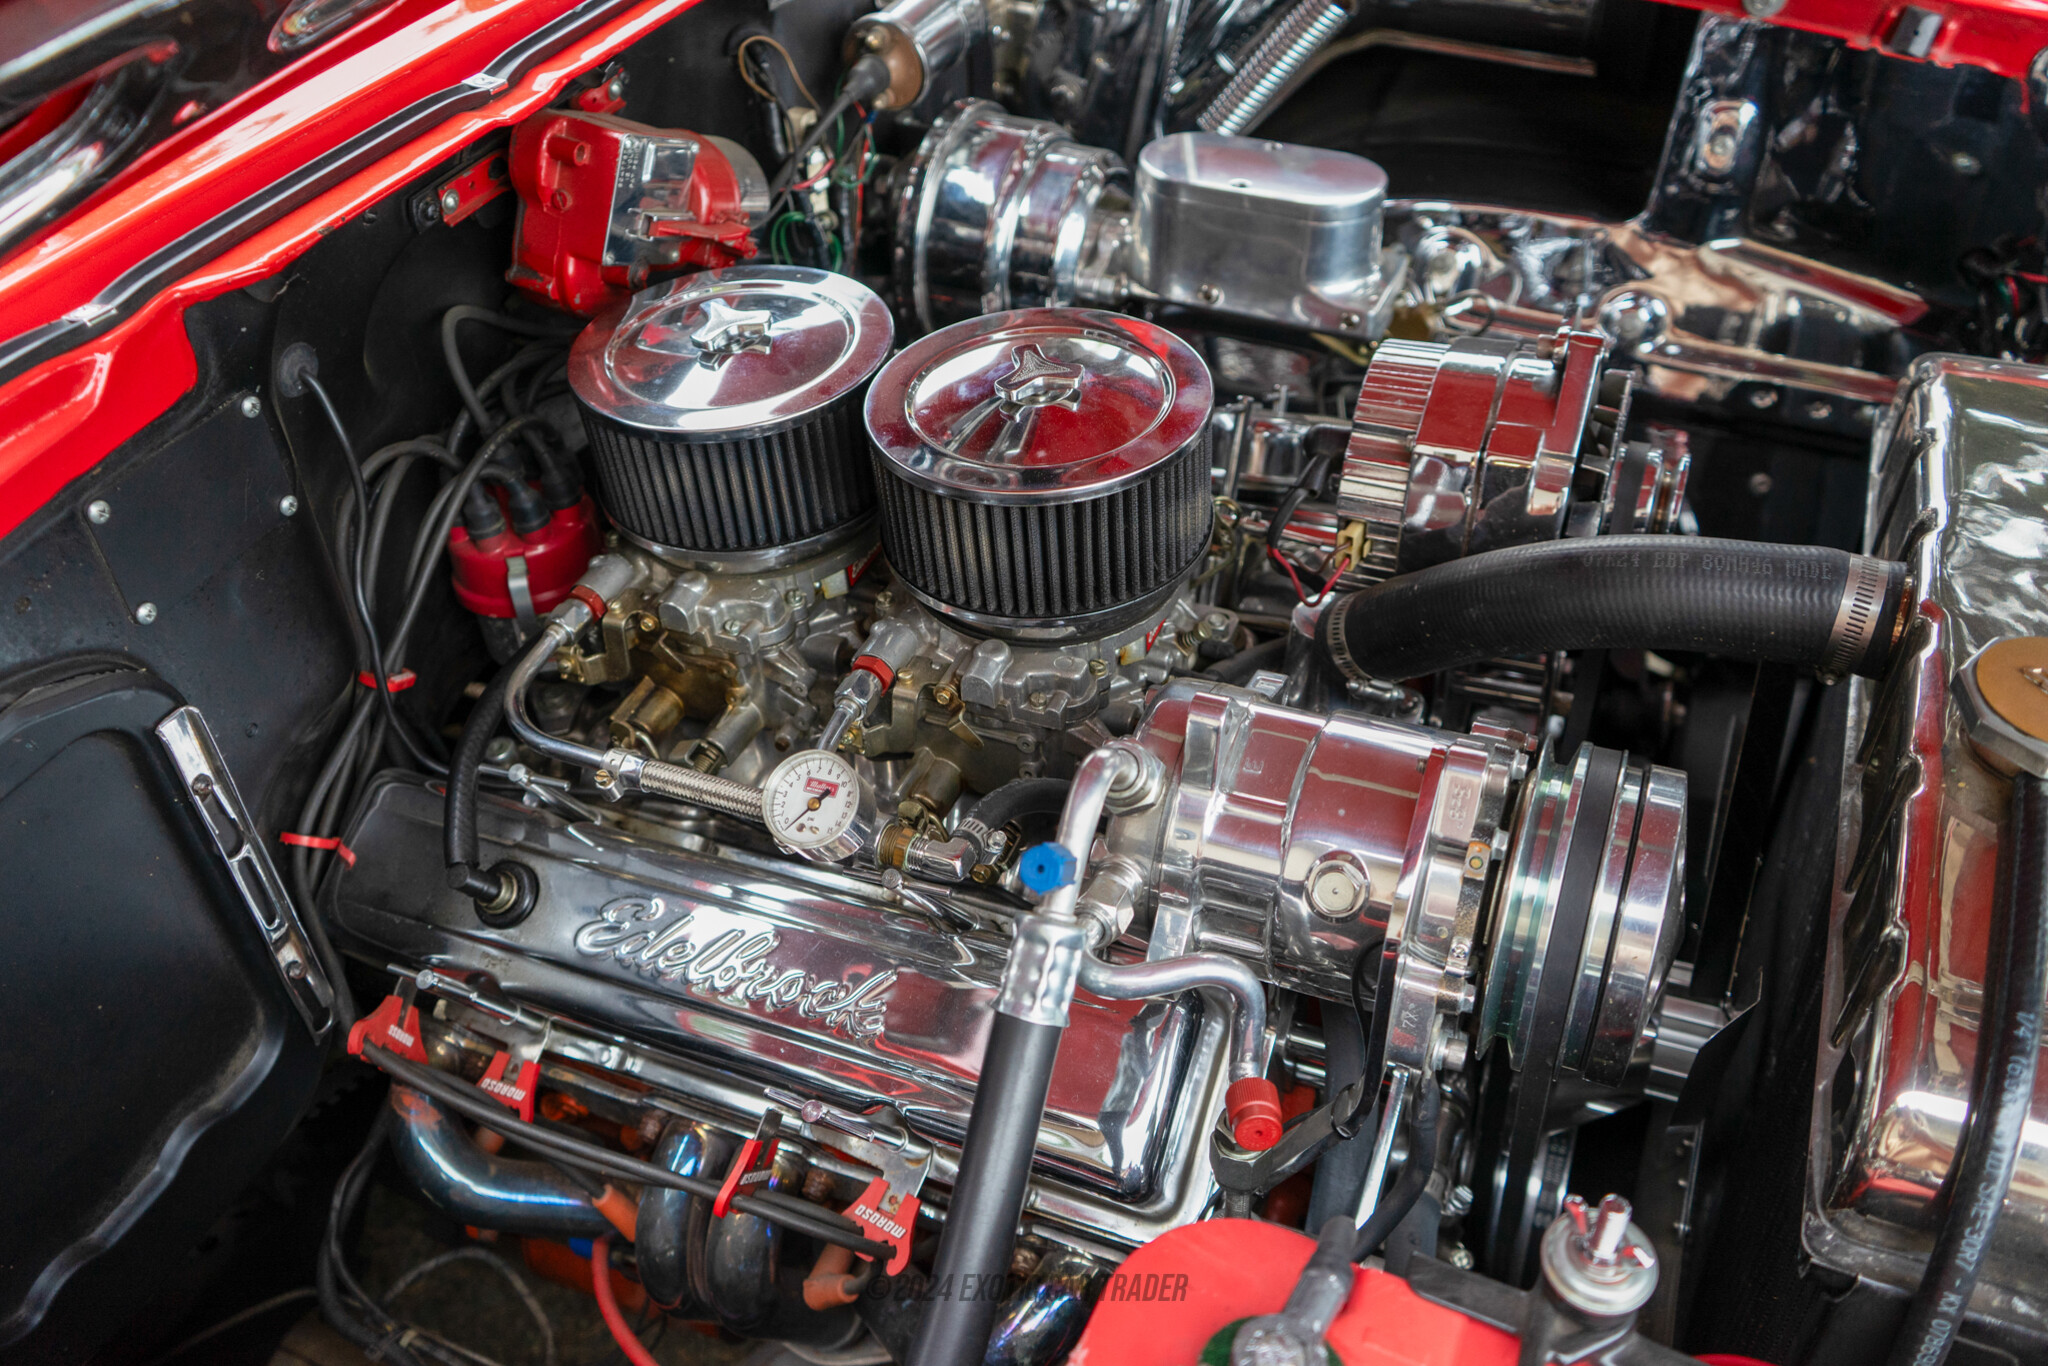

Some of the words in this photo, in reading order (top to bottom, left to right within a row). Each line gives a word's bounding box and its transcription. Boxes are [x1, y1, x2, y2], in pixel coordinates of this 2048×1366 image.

[1785, 559, 1832, 580] MADE
[573, 896, 898, 1039] Edelbrock
[480, 1077, 527, 1102] MOROSO
[854, 1203, 907, 1240] MOROSO
